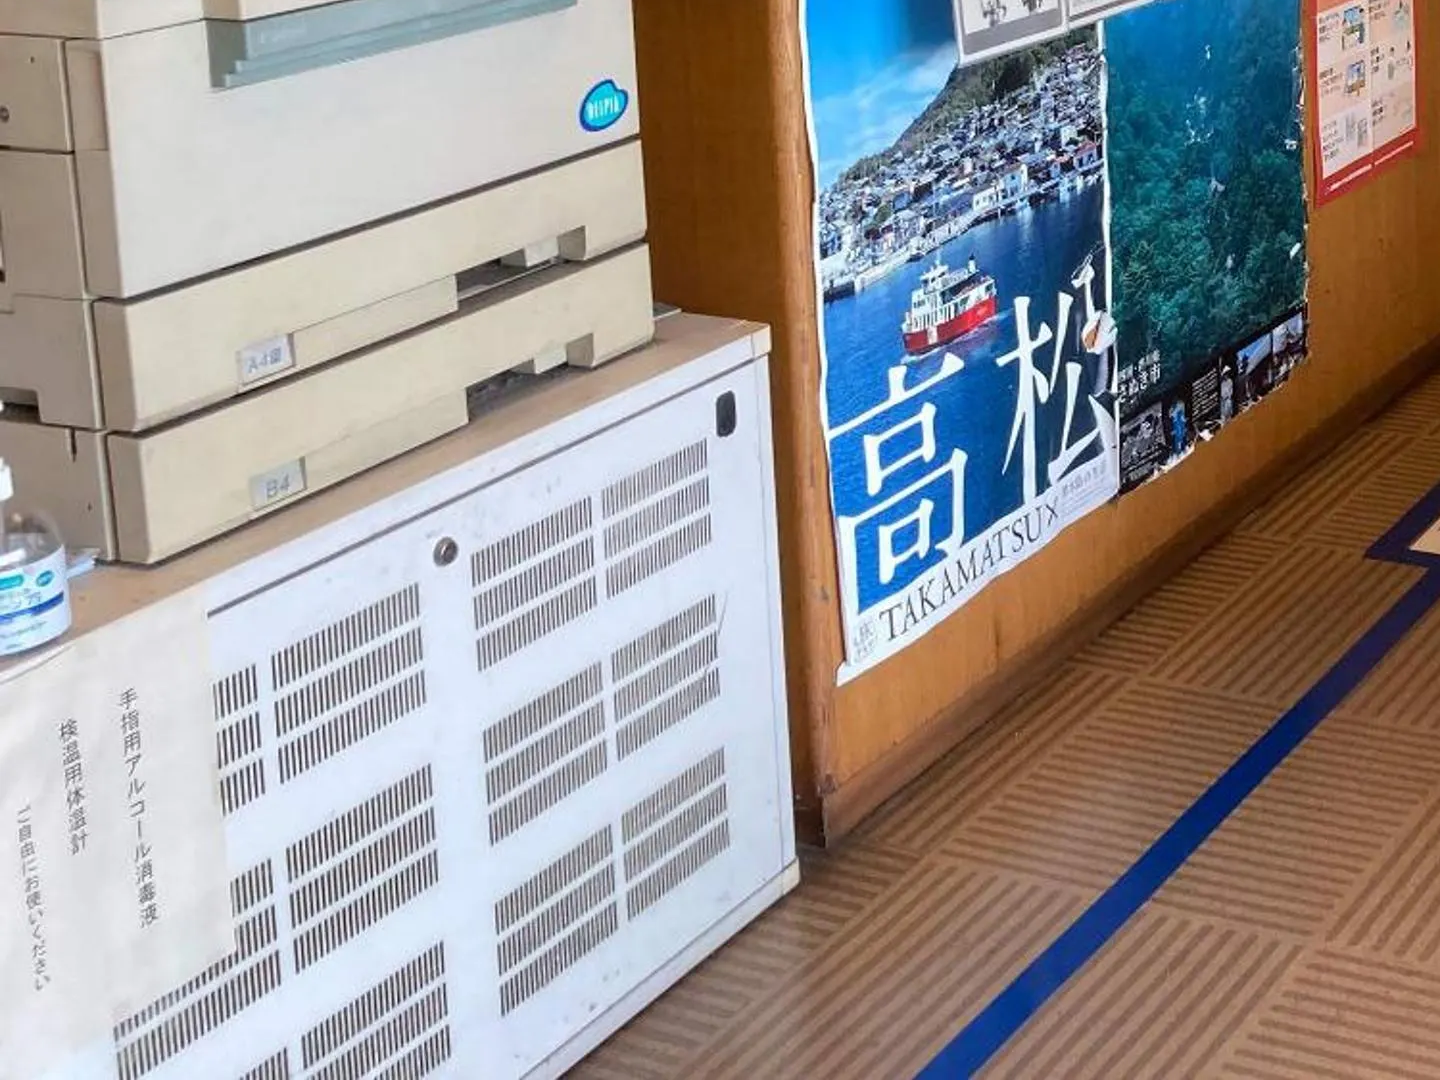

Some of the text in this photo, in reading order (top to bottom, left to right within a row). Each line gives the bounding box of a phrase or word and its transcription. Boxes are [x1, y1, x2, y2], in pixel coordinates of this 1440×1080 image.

[266, 473, 290, 499] B4
[825, 292, 1114, 605] 高松
[57, 718, 88, 856] 検温用体温計
[119, 687, 160, 928] 手指用アルコール消毒液
[17, 805, 50, 992] ご自由にお使いください
